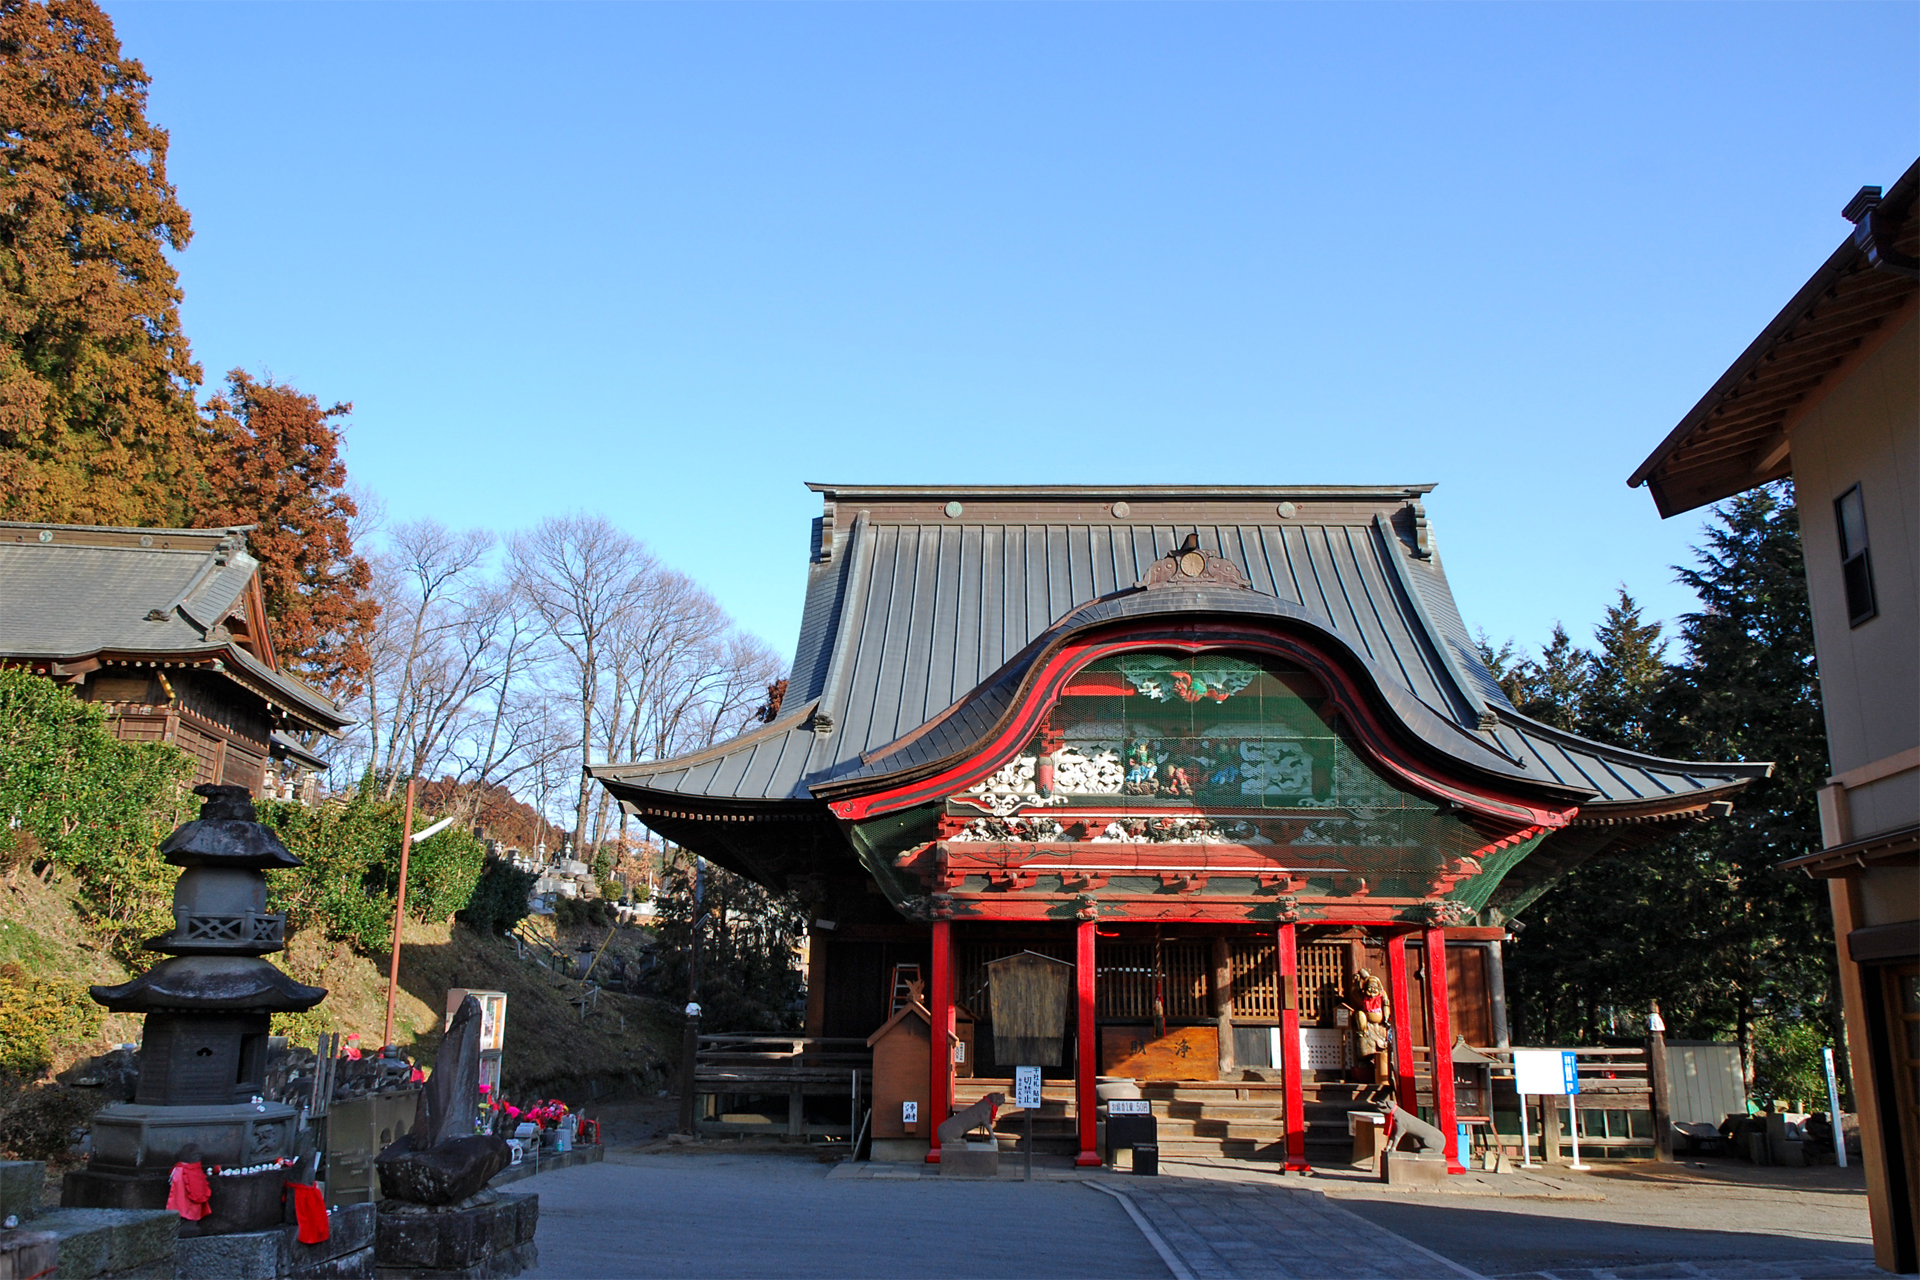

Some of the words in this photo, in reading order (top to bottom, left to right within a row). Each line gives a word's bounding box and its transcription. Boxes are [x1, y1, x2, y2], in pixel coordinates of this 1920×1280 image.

[1023, 1070, 1032, 1103] 一切禁止
[1136, 1101, 1148, 1112] 50円
